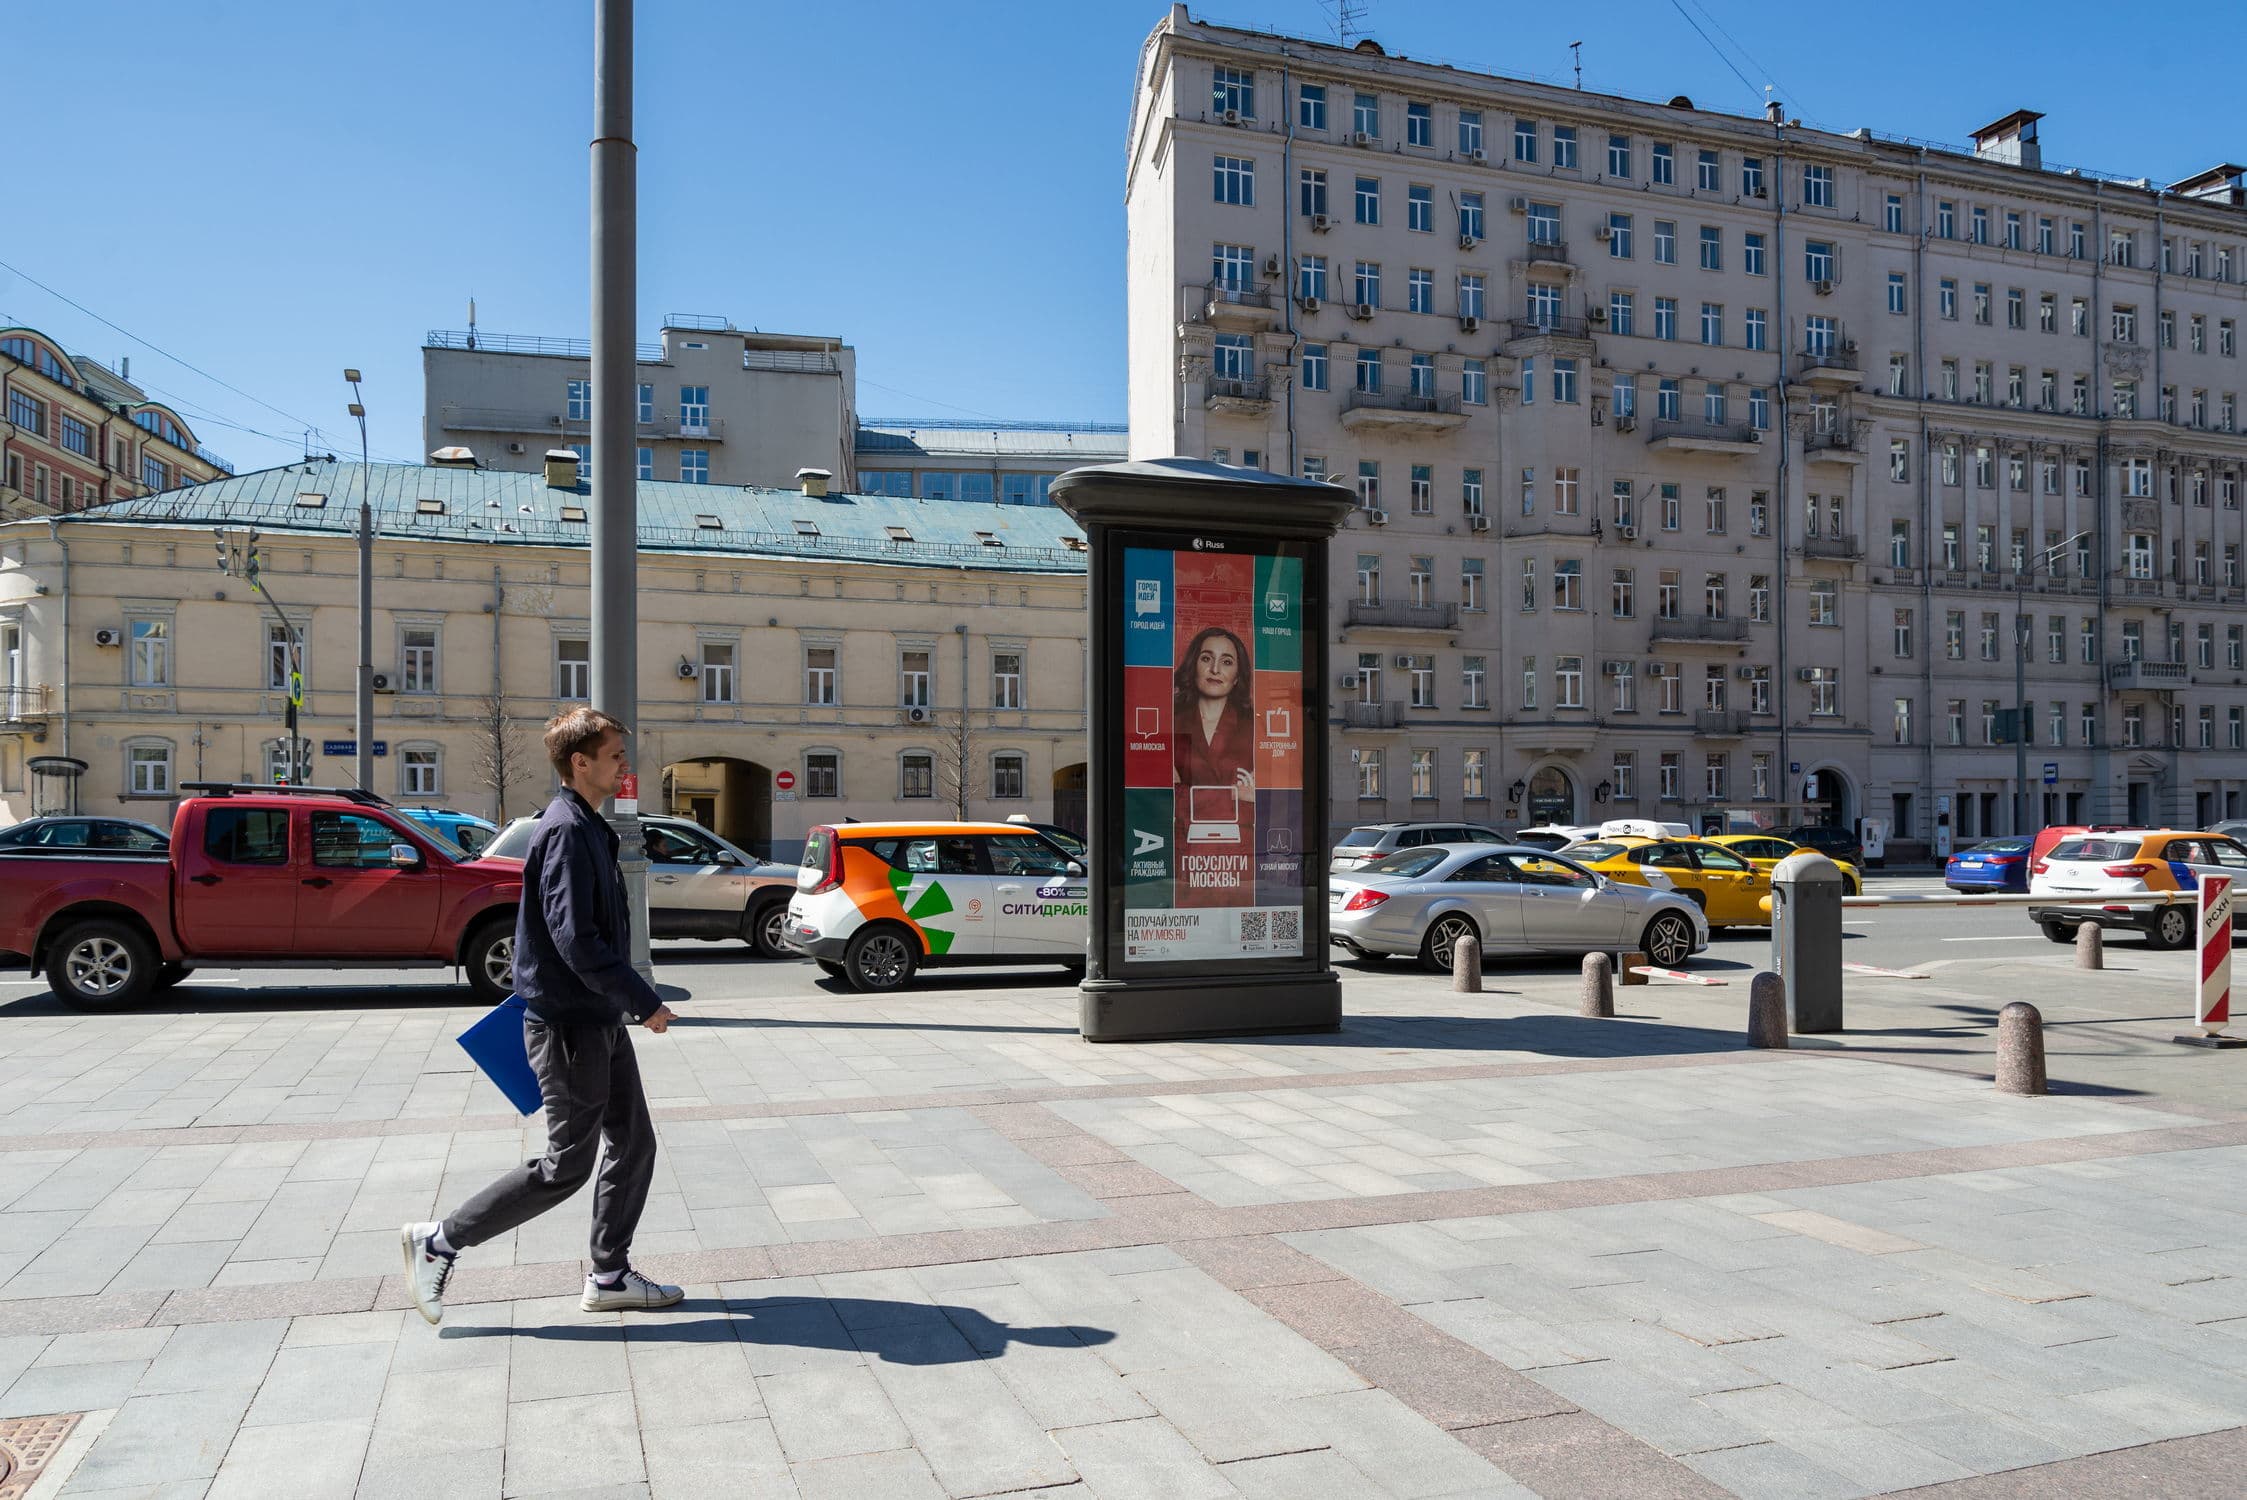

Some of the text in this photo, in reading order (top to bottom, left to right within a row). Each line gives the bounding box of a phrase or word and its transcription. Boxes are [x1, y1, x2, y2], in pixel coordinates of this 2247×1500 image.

[1206, 540, 1225, 549] Russ
[1138, 582, 1158, 592] ГОРОД
[1138, 591, 1156, 601] ИДЕЙ
[1130, 621, 1165, 630] ГОРОД ИДЕЙ
[1143, 742, 1166, 750] МОСКВА
[1133, 859, 1165, 869] АКТИВНЫЙ
[1181, 855, 1248, 871] ГОСУСЛУГИ
[1130, 868, 1167, 877] ГРАЖДАНИН
[1189, 871, 1240, 887] МОСКВЫ
[1038, 887, 1066, 897] -80%
[1127, 914, 1200, 928] ПОЛУЧАЙ УСЛУГИ
[1127, 928, 1186, 941] НА MY.MOS.RU
